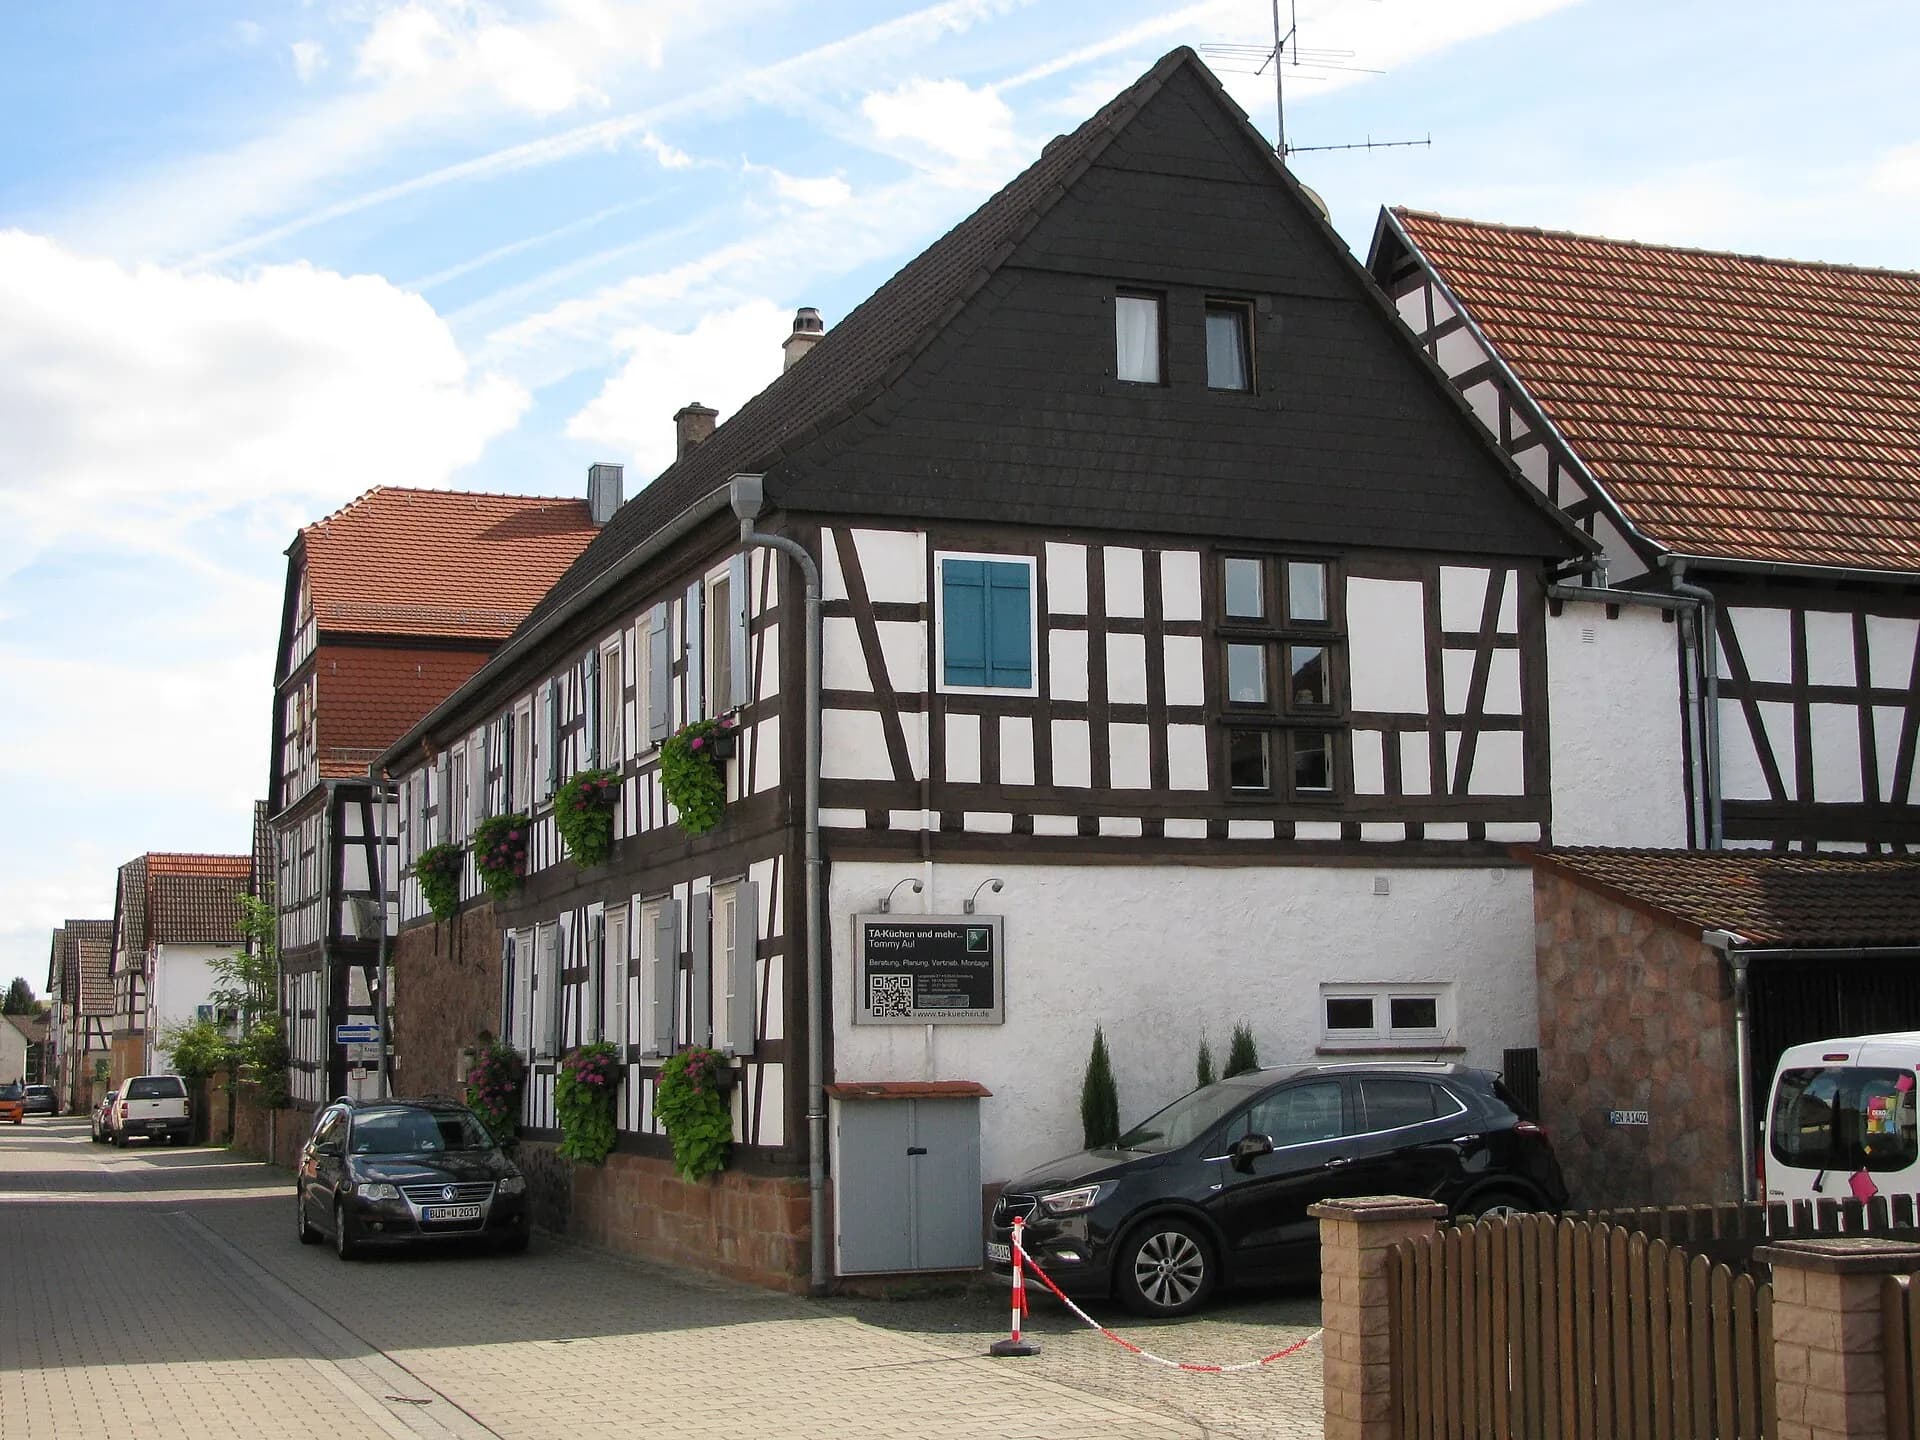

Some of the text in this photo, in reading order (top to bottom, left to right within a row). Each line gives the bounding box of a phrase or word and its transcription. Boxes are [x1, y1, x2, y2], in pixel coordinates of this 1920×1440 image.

[917, 928, 933, 938] und
[869, 939, 915, 950] Tommy Aul
[459, 1207, 479, 1217] 2017
